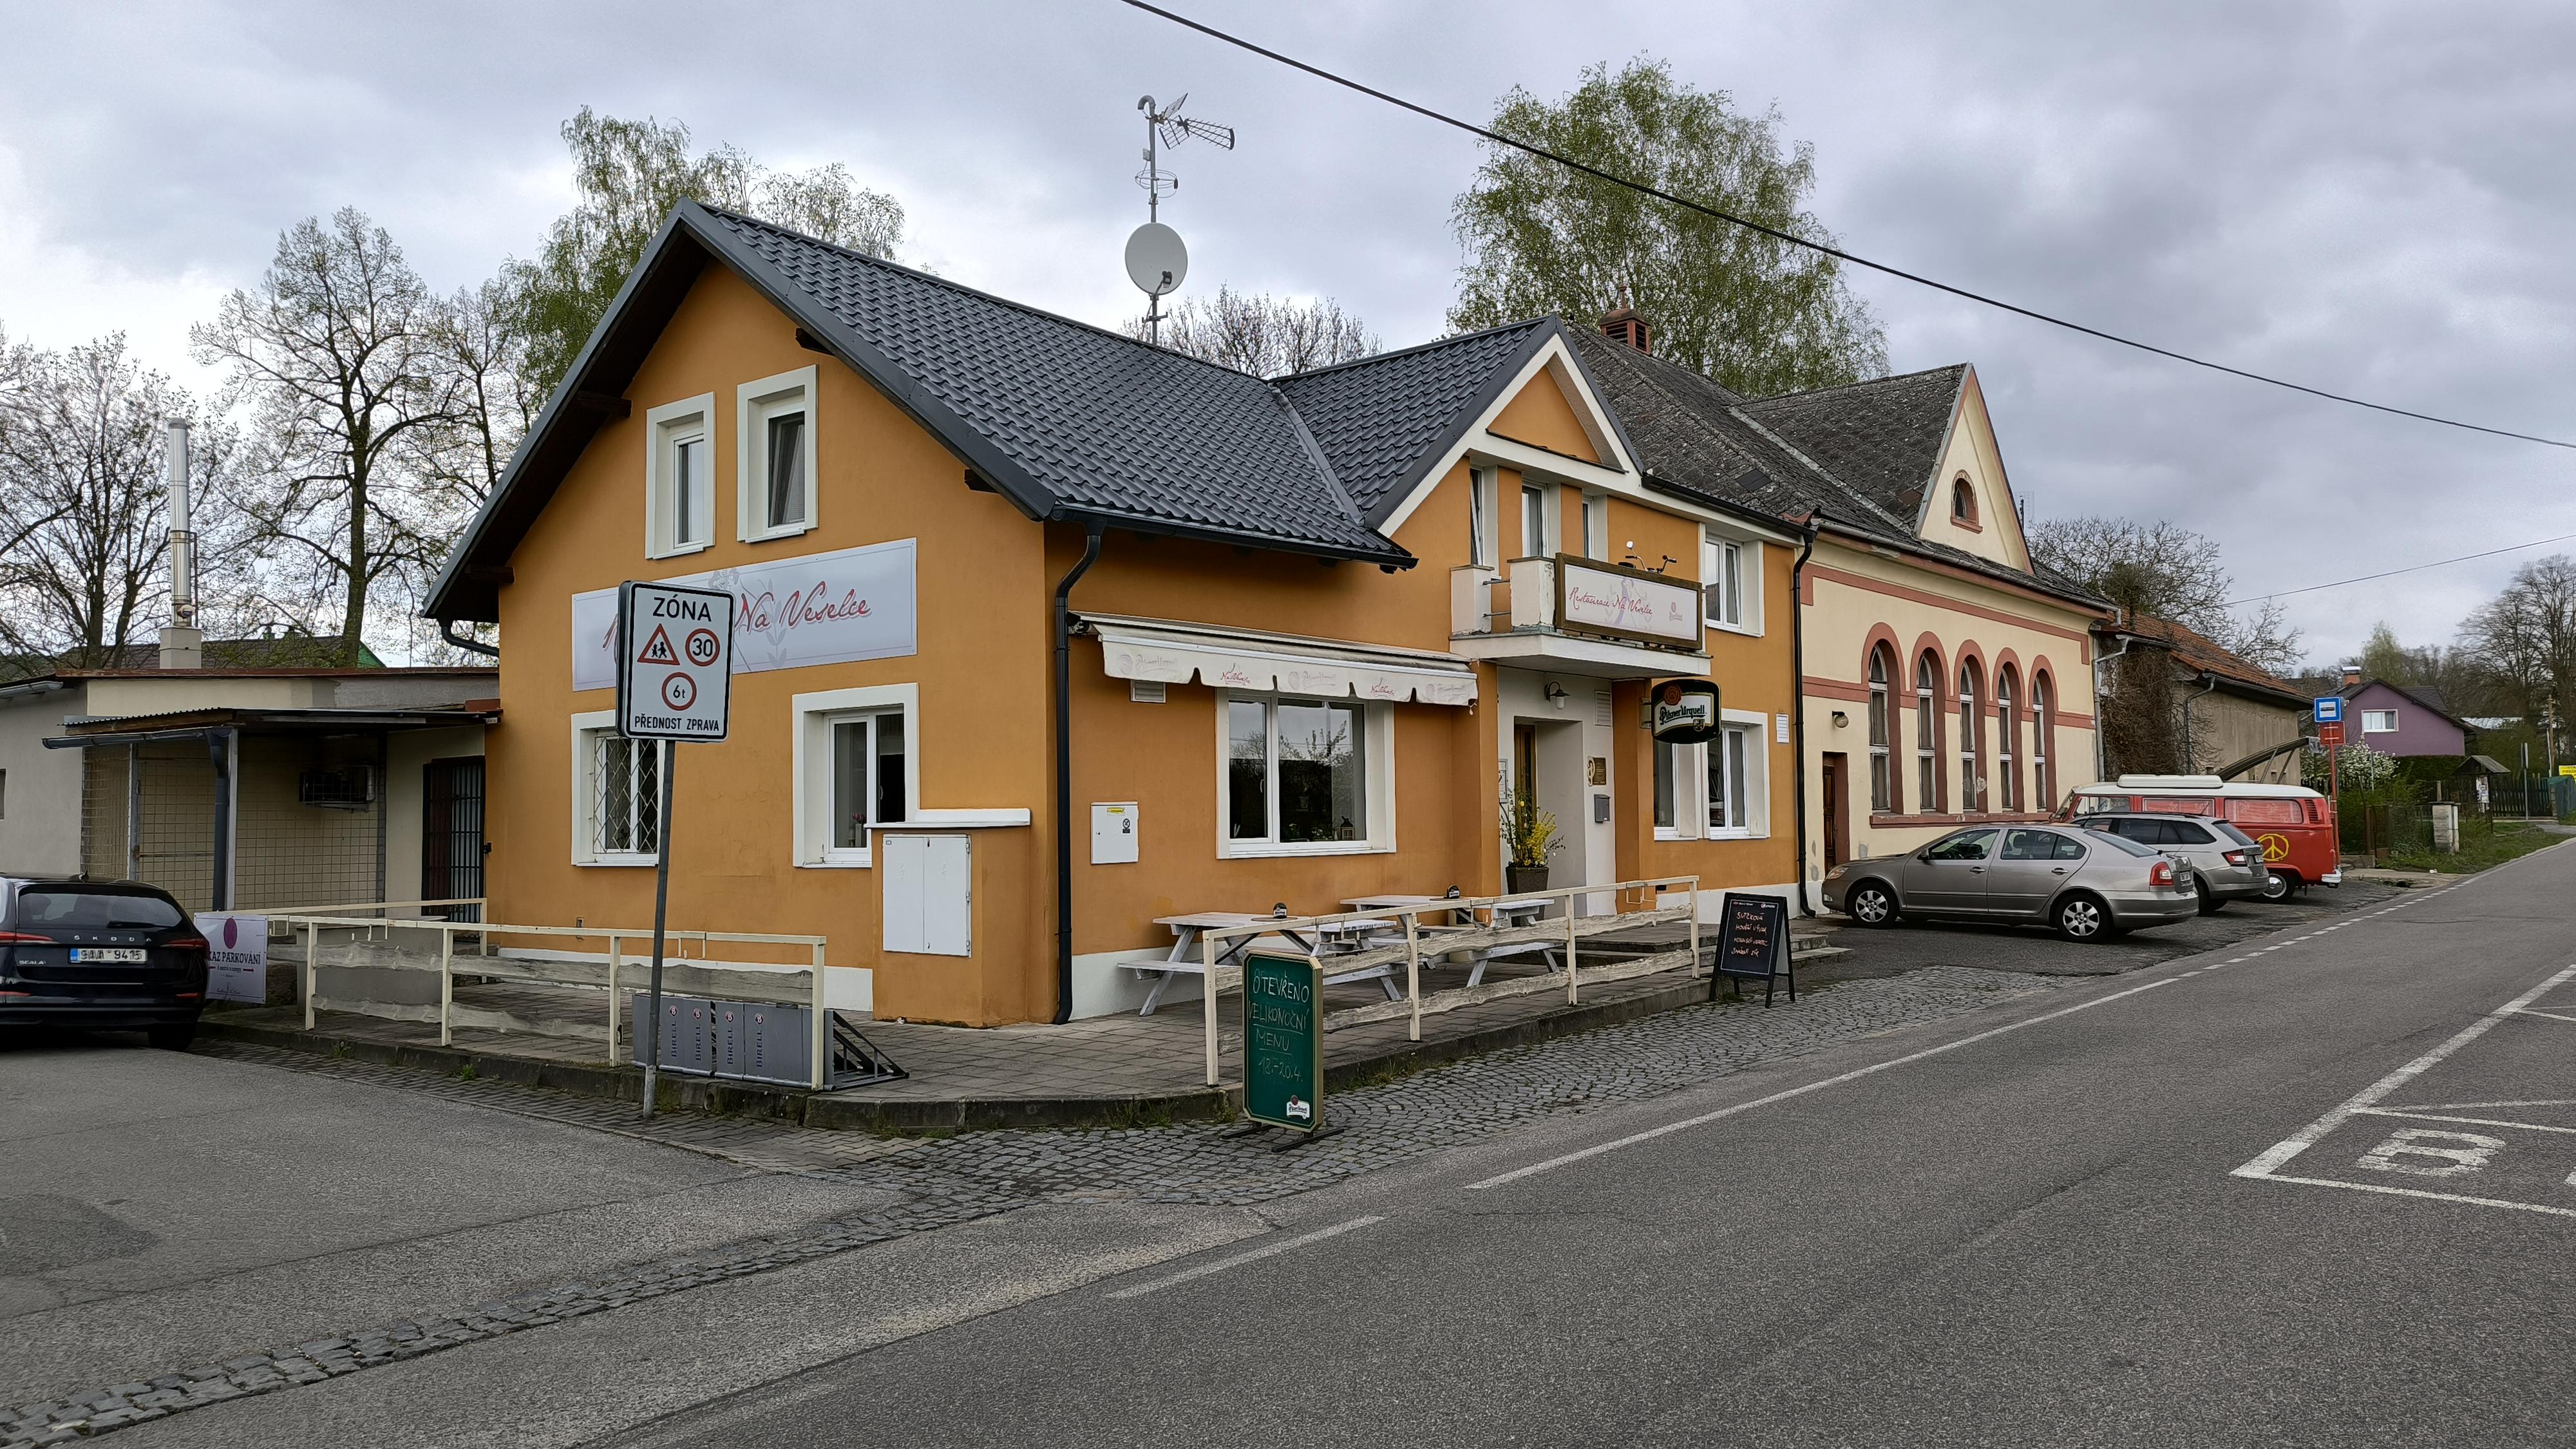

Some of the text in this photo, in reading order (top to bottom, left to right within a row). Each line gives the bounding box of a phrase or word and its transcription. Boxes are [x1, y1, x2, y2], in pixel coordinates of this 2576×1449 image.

[652, 594, 712, 622] ZÓNA
[734, 581, 871, 632] Na Veselce
[1612, 594, 1626, 610] Na
[692, 638, 713, 657] 30
[635, 713, 719, 732] PŘEDNOST ZPRAVA
[1660, 705, 1705, 725] Pilsner Urquell
[222, 951, 261, 965] PARKOVÁNÍ
[1253, 970, 1309, 1003] OTEVŘENO
[1256, 1030, 1289, 1052] MENU
